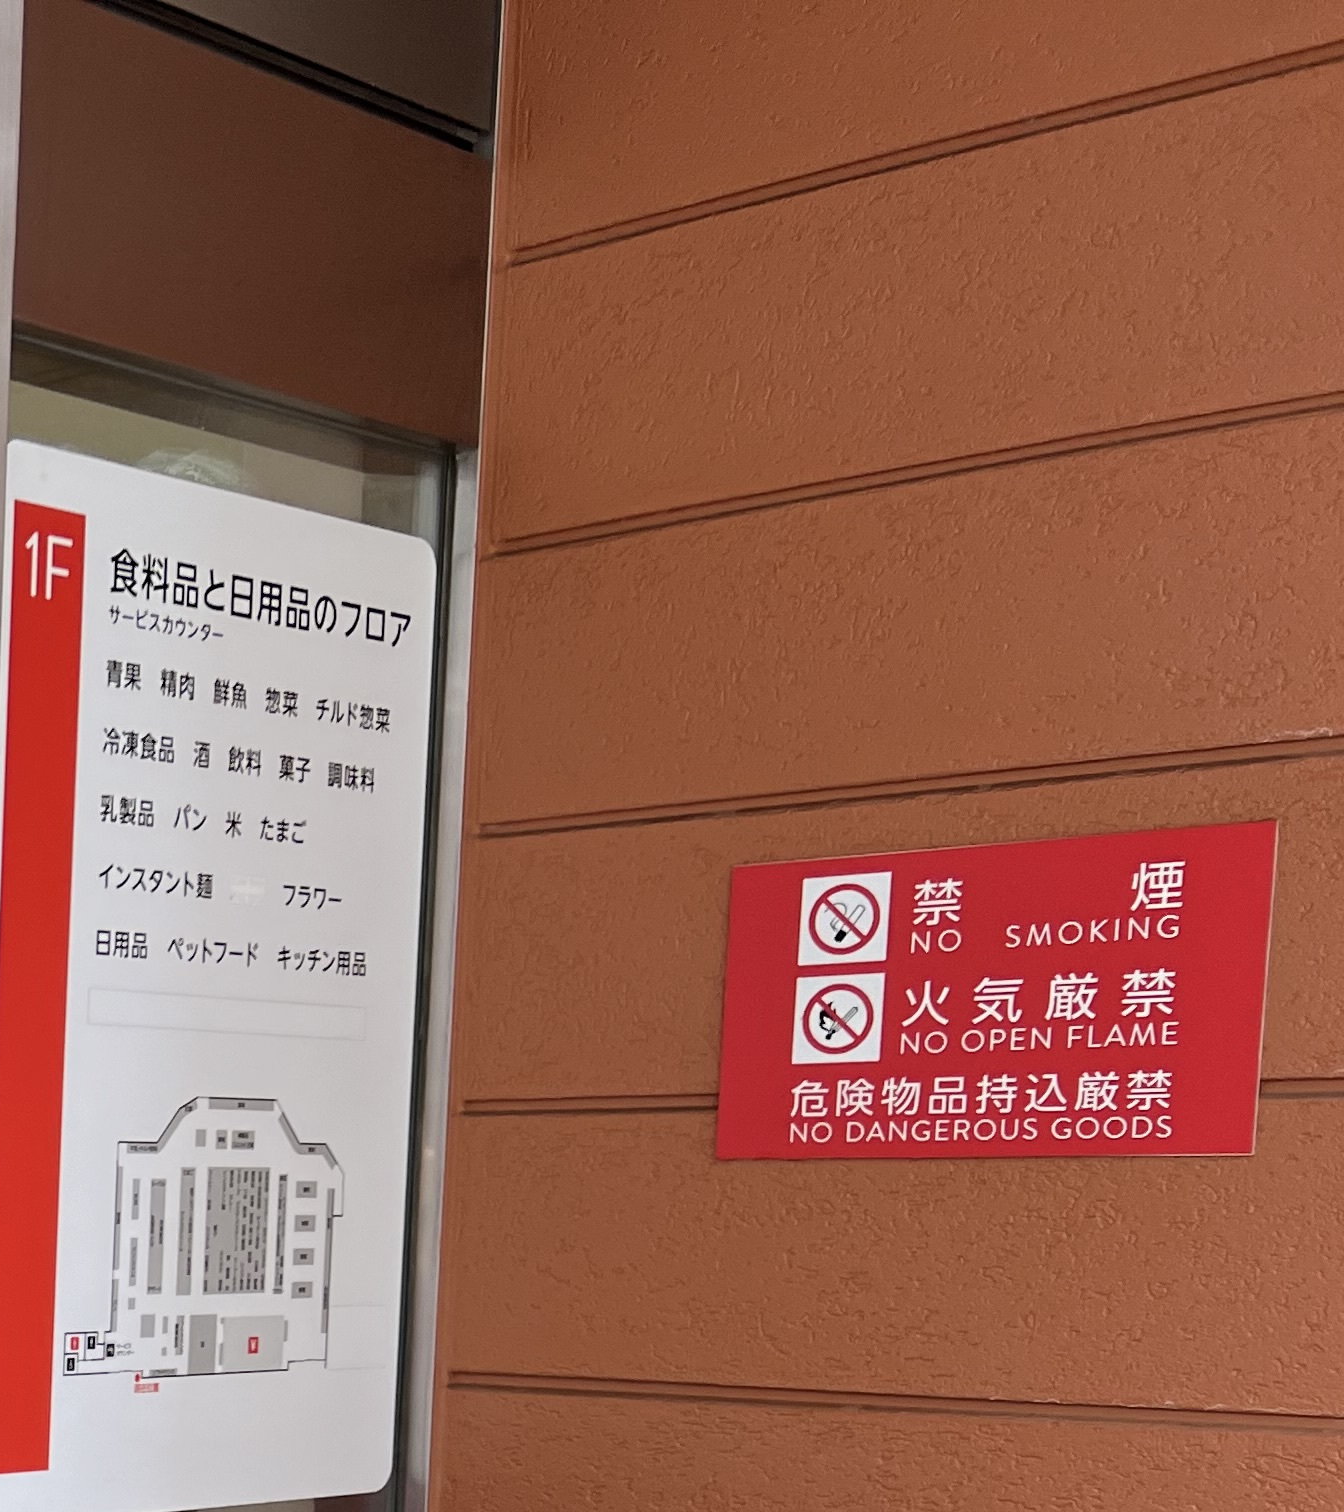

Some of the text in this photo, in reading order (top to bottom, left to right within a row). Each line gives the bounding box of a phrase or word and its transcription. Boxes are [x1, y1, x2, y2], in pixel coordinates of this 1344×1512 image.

[25, 530, 73, 600] 1F
[110, 548, 411, 647] 食料品と日用品のフロア
[109, 605, 224, 642] サービスカウンター
[105, 659, 392, 733] 青果 精肉 鮮魚 惣菜 チルド惣菜
[102, 726, 375, 794] 冷凍食品 酒 飲料 菓子 調味料
[100, 794, 308, 845] 乳製品 パン 米 たまご
[98, 863, 343, 910] インスタント麺 フラワー
[95, 929, 367, 978] 日用品 ペットフード キッチン用品
[910, 913, 1181, 955] NO SMOKING
[900, 967, 1177, 1028] 火気厳禁
[899, 1020, 1179, 1056] NO OPEN FLAME
[789, 1068, 1172, 1119] 危険物品持込厳禁
[788, 1114, 1173, 1145] NO DANGEROUS GOODS
